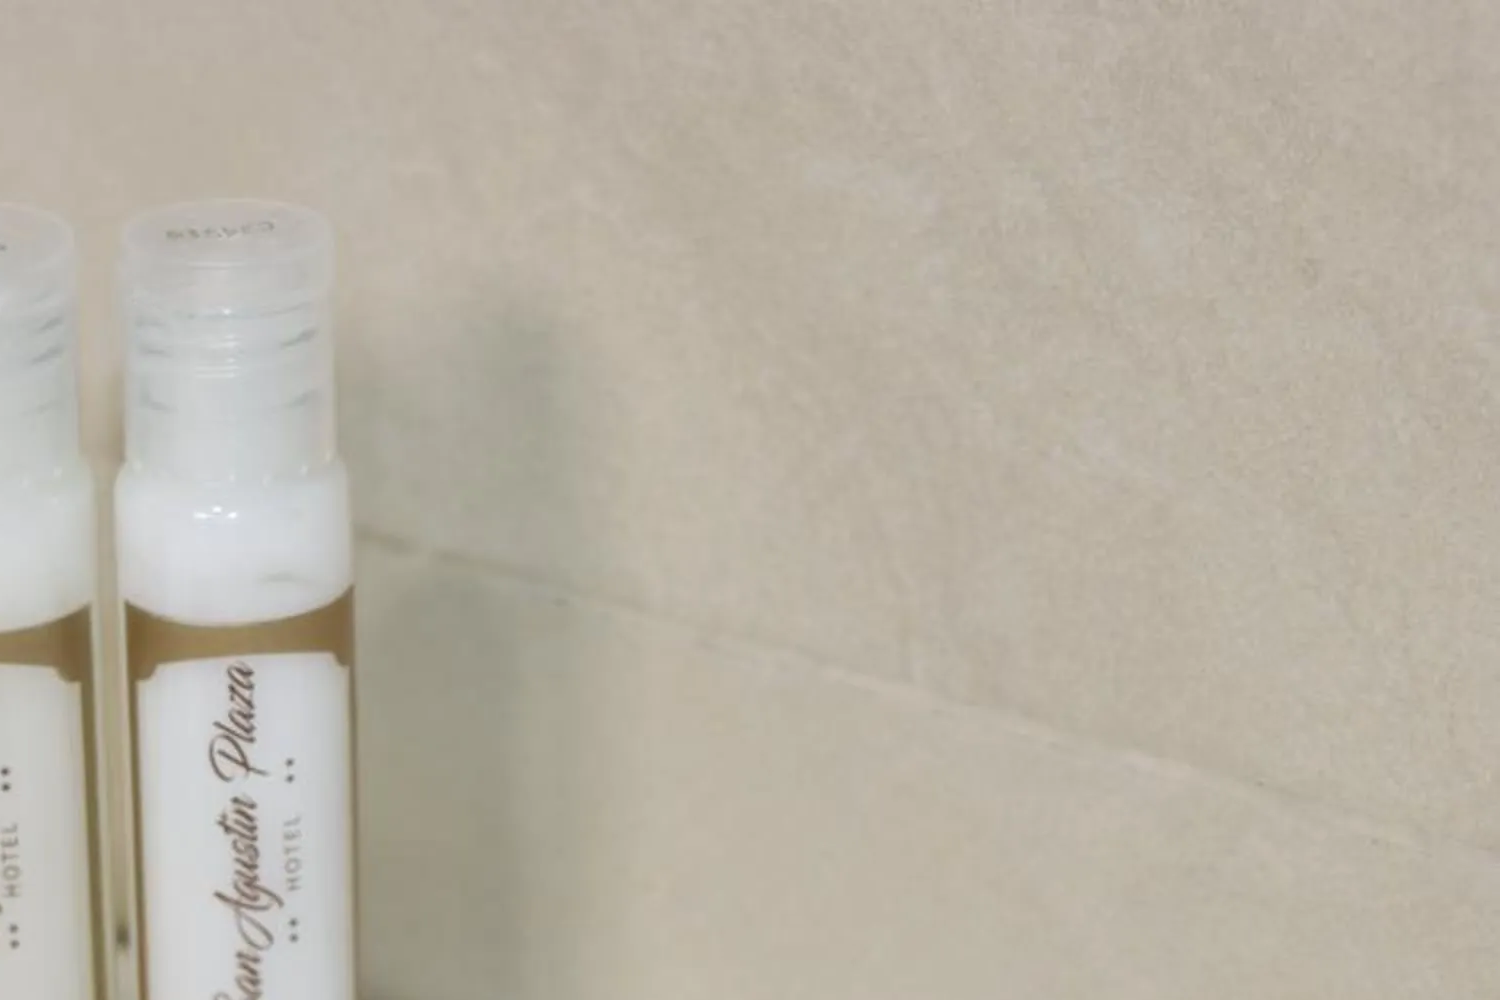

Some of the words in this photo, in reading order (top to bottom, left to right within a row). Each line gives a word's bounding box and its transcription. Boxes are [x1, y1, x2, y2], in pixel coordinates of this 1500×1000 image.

[209, 660, 268, 782] Plaza
[2, 822, 21, 898] HOTEL
[284, 815, 301, 891] HOTEL
